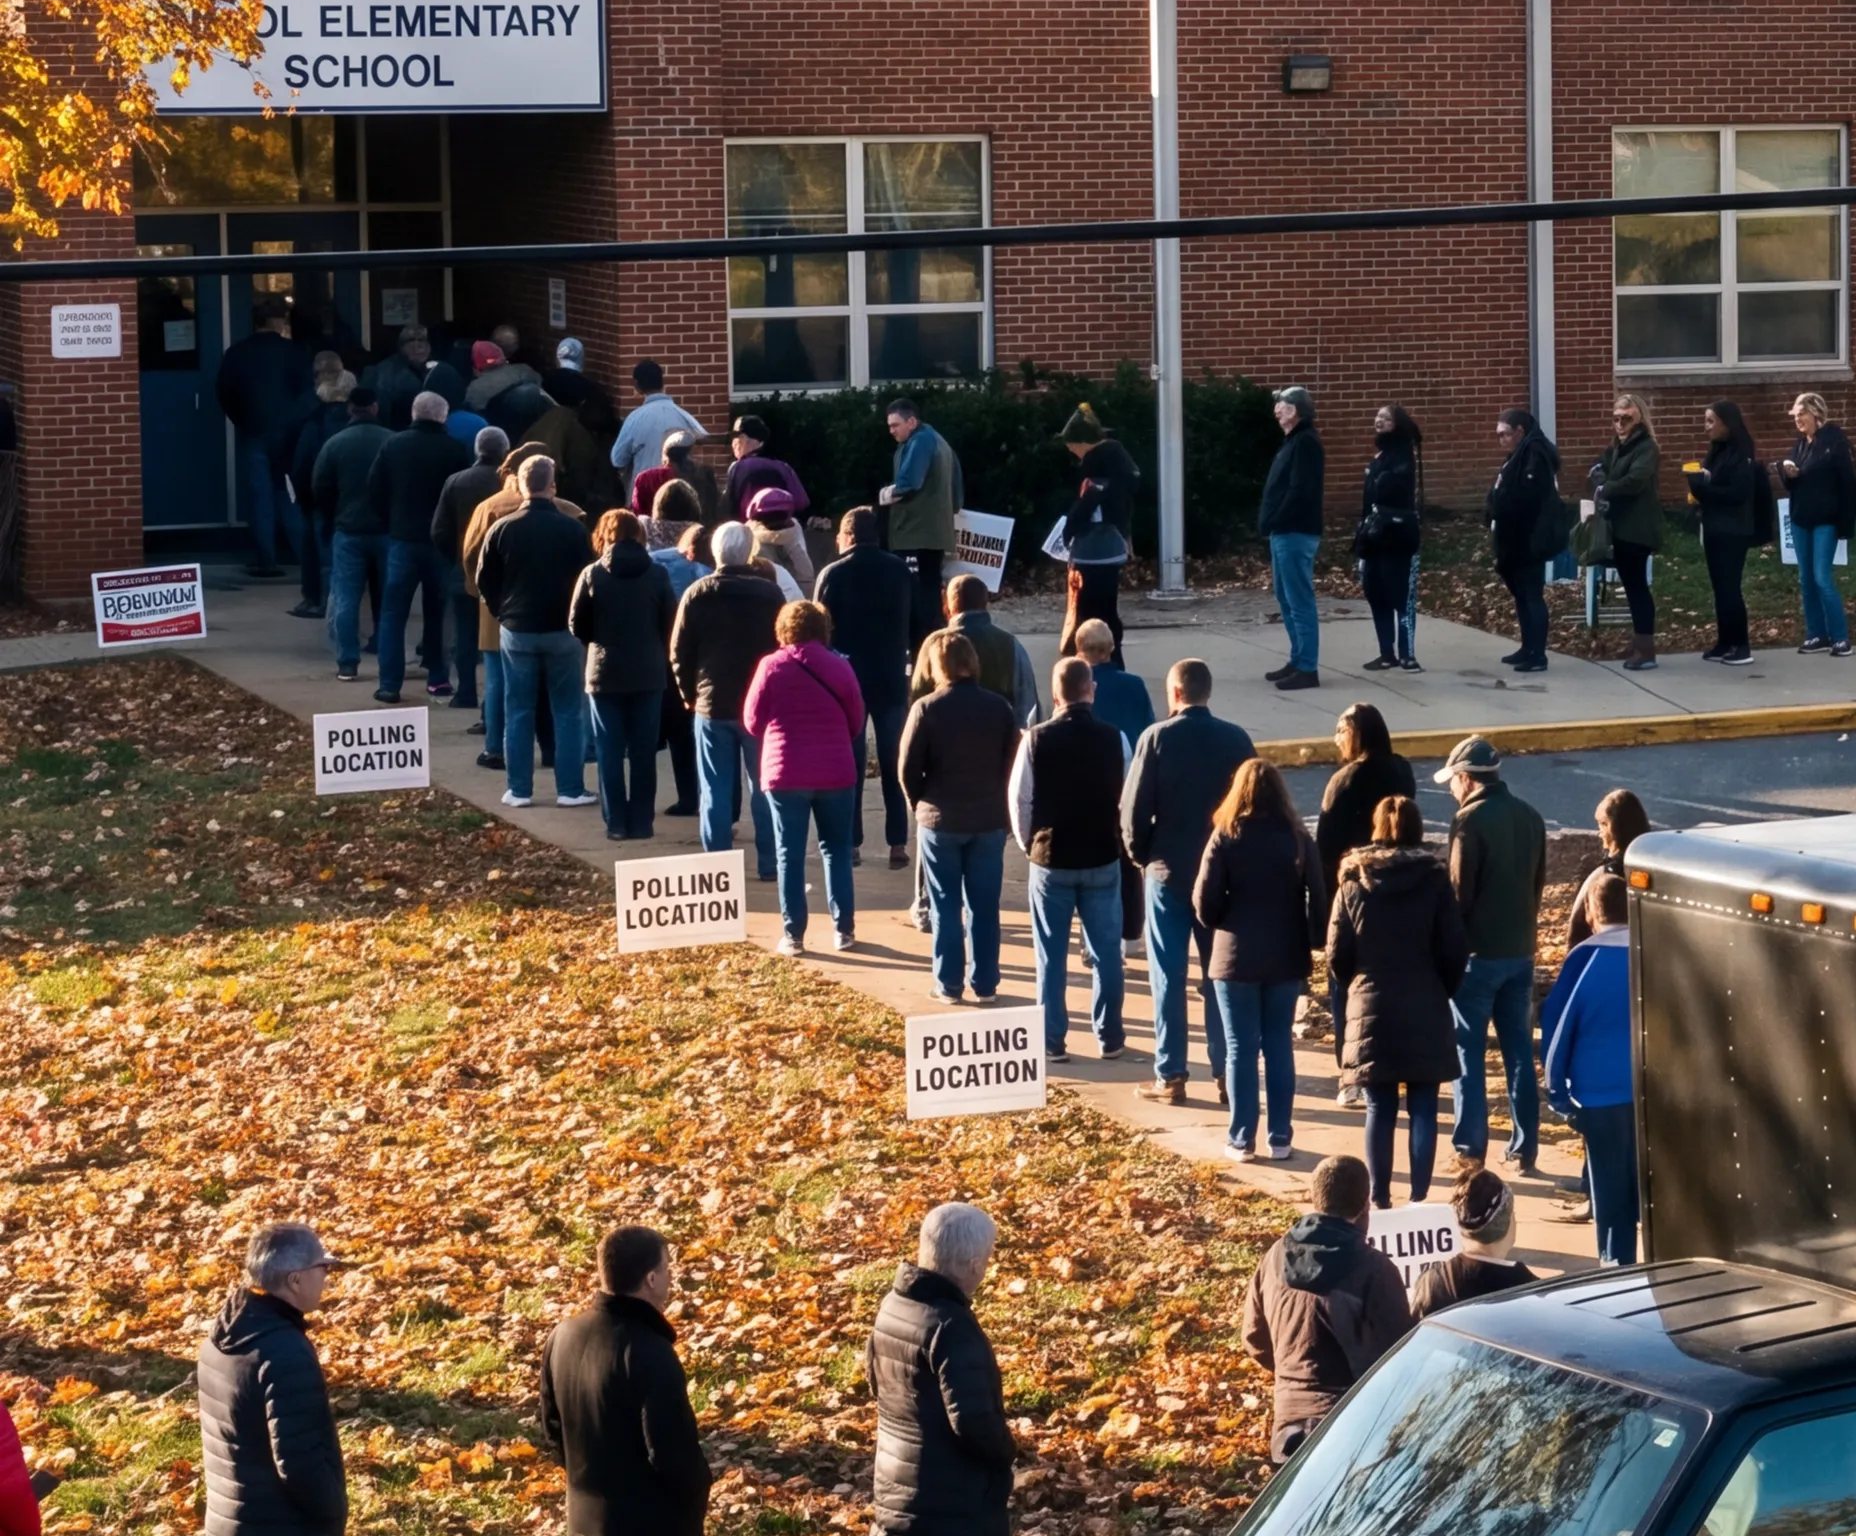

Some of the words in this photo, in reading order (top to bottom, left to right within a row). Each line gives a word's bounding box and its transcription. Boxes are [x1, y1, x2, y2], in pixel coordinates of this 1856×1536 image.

[256, 4, 303, 38] OL
[320, 4, 580, 38] ELEMENTARY
[284, 54, 455, 89] SCHOOL
[328, 724, 416, 749] POLLING
[321, 748, 423, 775] LOCATION
[632, 871, 730, 901] POLLING
[626, 899, 739, 930] LOCATION
[923, 1027, 1028, 1059] POLLING
[915, 1058, 1037, 1092] LOCATION
[1368, 1227, 1453, 1258] LLING
